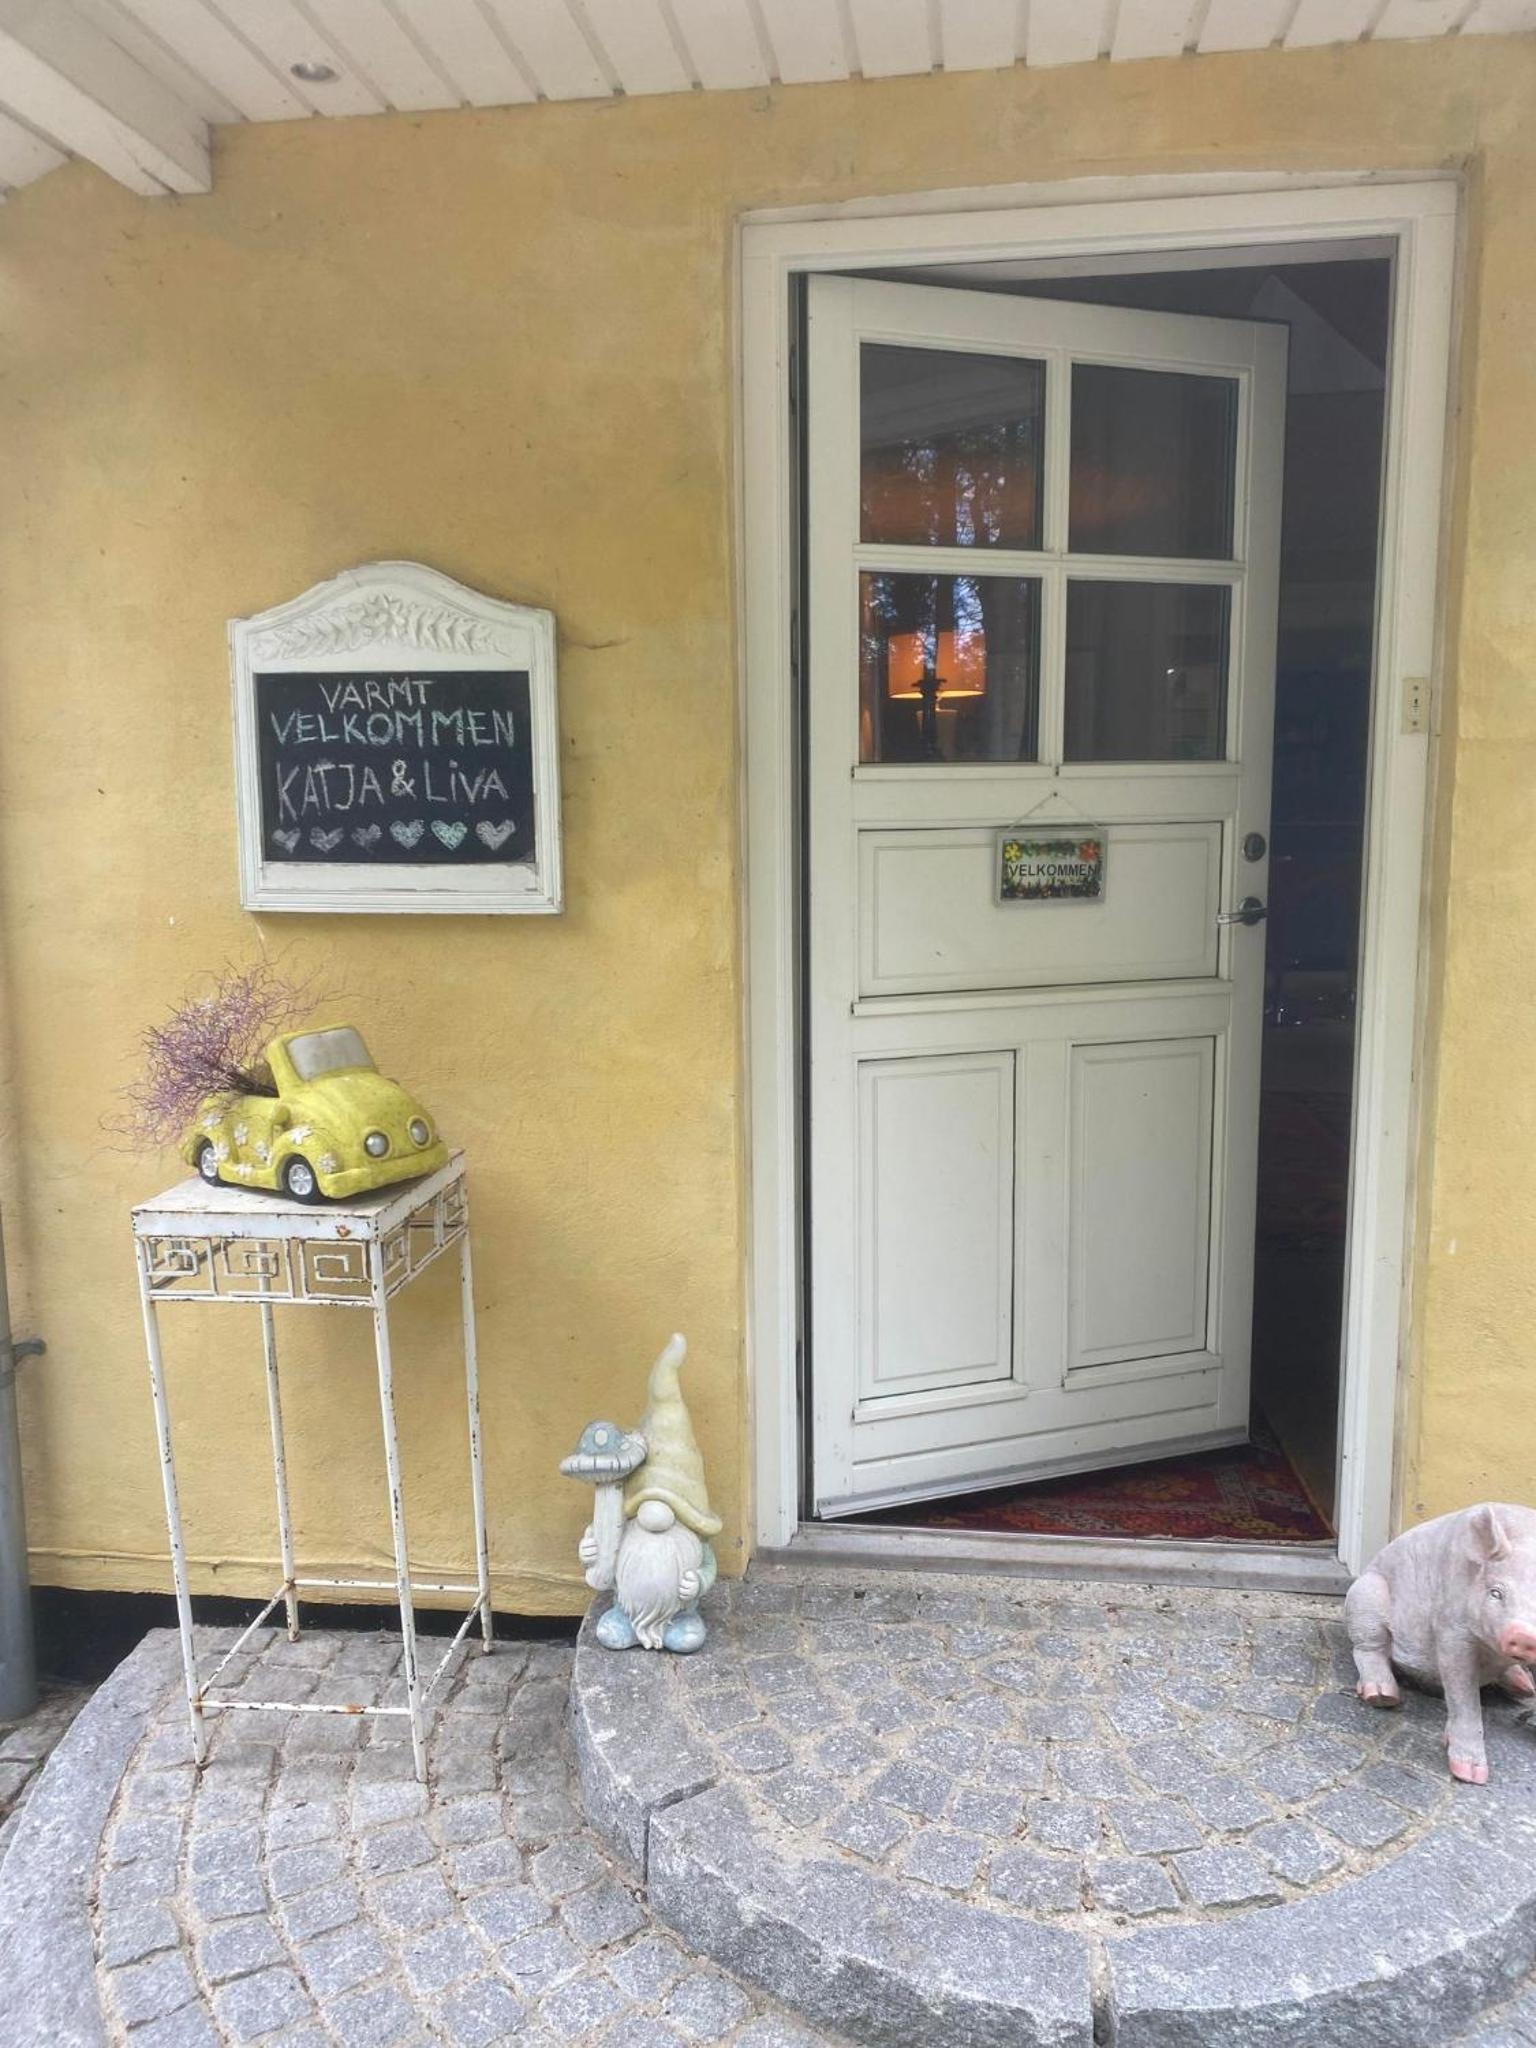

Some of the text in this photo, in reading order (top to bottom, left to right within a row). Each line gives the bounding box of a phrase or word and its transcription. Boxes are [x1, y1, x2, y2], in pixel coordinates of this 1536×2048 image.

[319, 676, 434, 714] VARMT
[271, 708, 516, 748] VELKOMMEN
[275, 758, 385, 823] KATJA
[391, 759, 416, 798] &
[1008, 863, 1098, 877] VELKOMMEN
